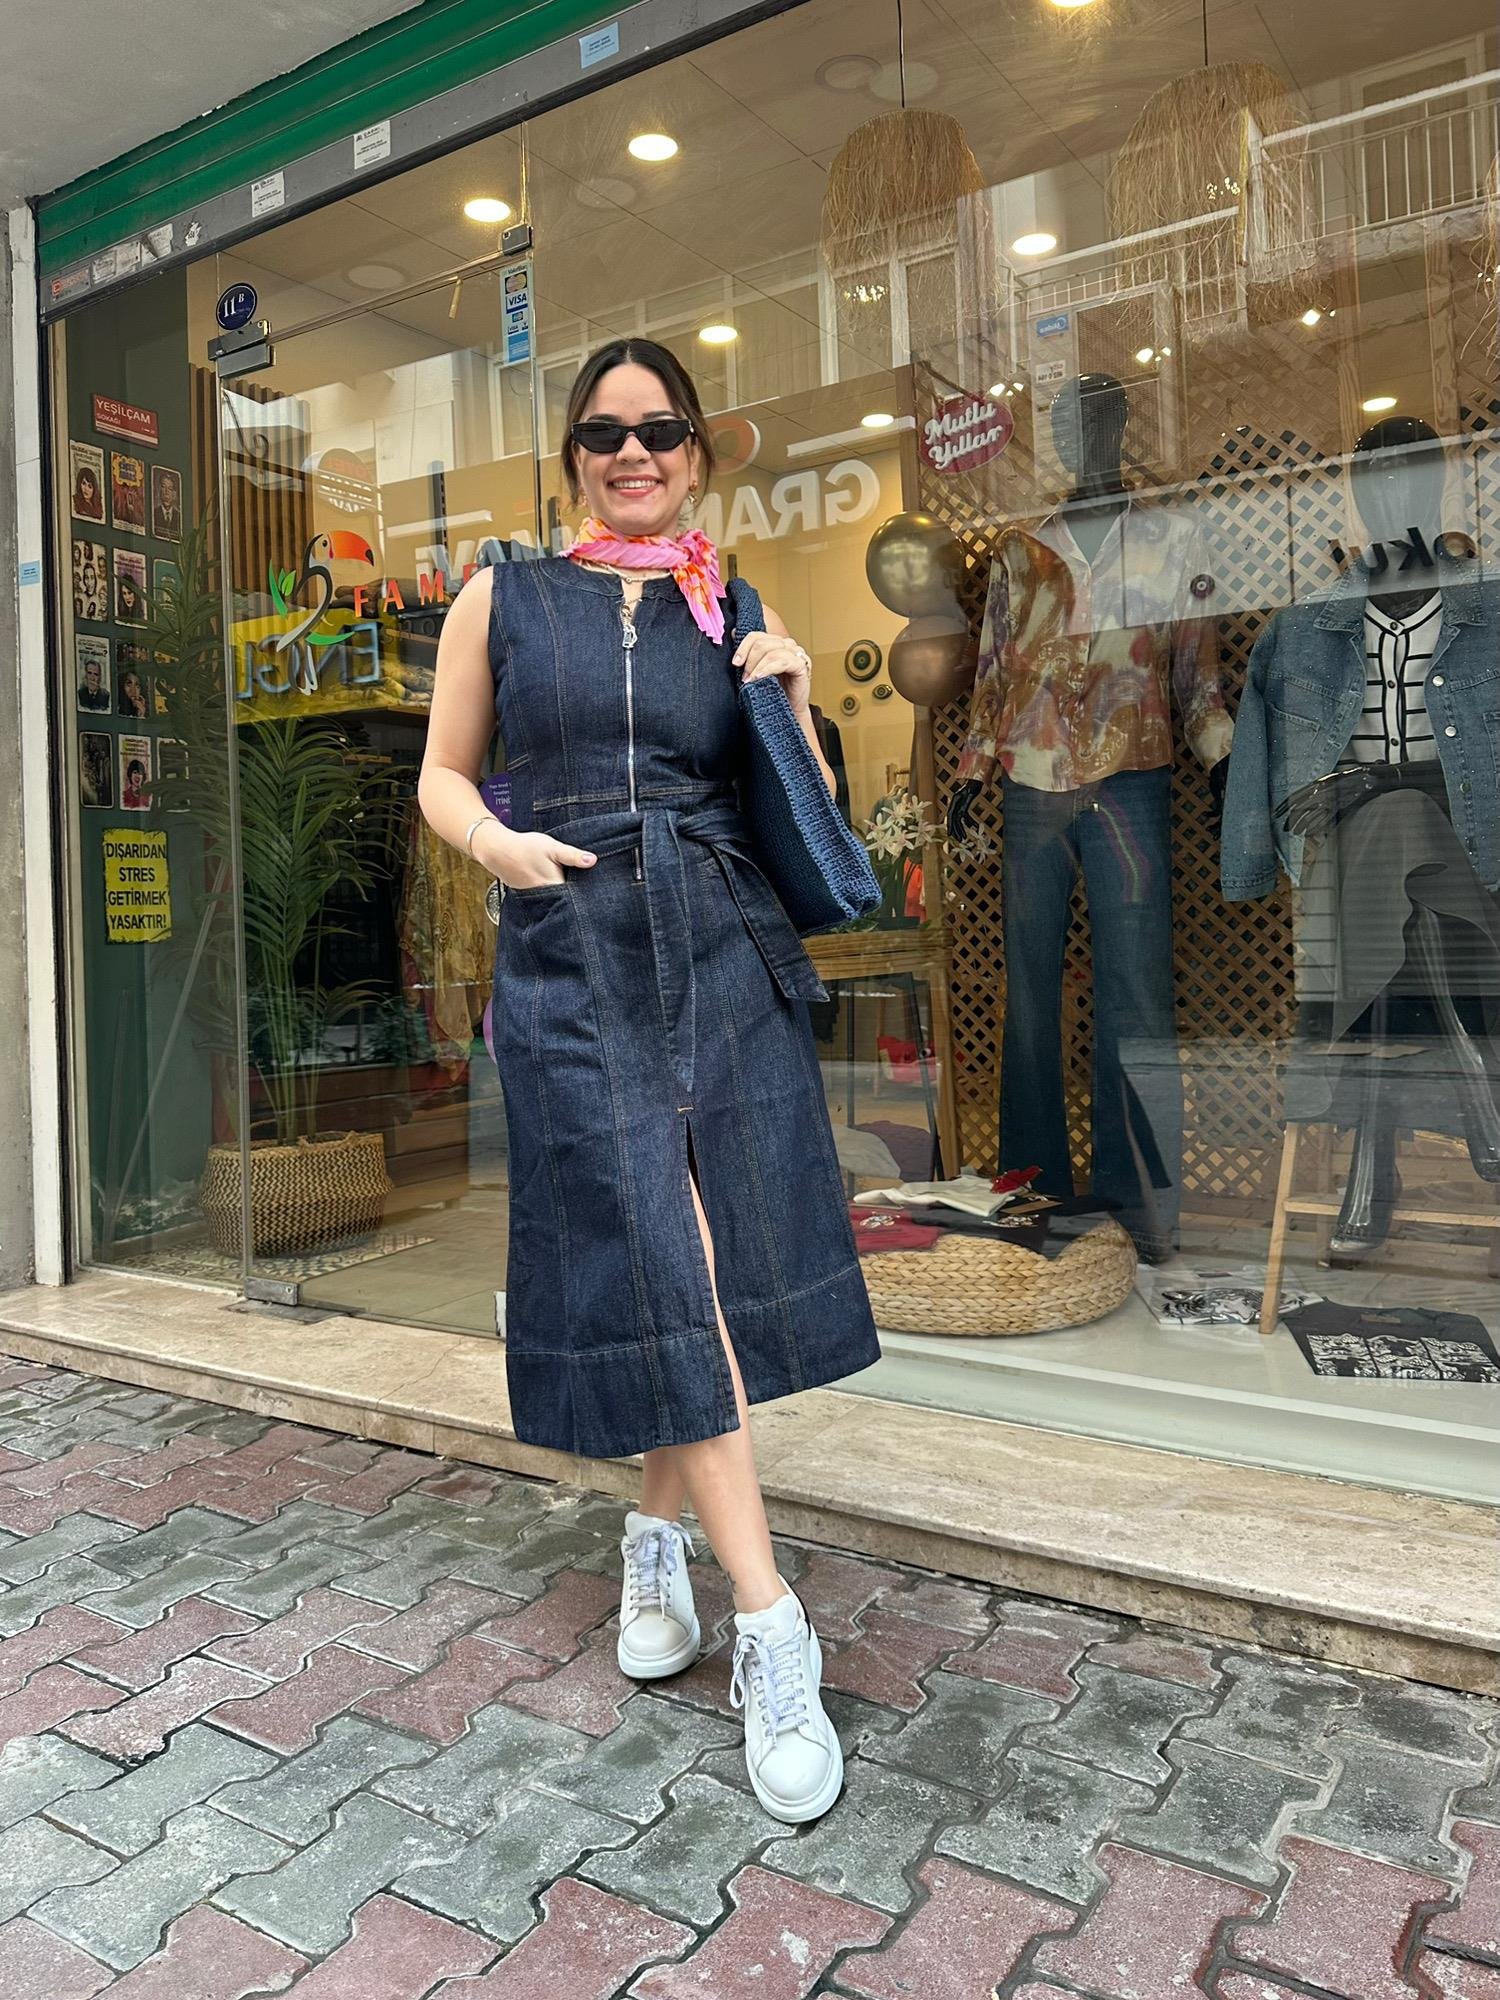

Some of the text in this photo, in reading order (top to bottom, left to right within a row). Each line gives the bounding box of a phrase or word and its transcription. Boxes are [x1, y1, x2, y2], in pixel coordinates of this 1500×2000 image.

[509, 293, 528, 306] VISA
[96, 399, 151, 424] YEŞİLÇAM
[925, 401, 997, 445] Mutlu
[106, 842, 167, 861] DIŞARIDAN
[119, 867, 155, 882] STRES
[108, 887, 168, 906] GETİRMEK
[110, 914, 167, 930] YASAKTIR!
